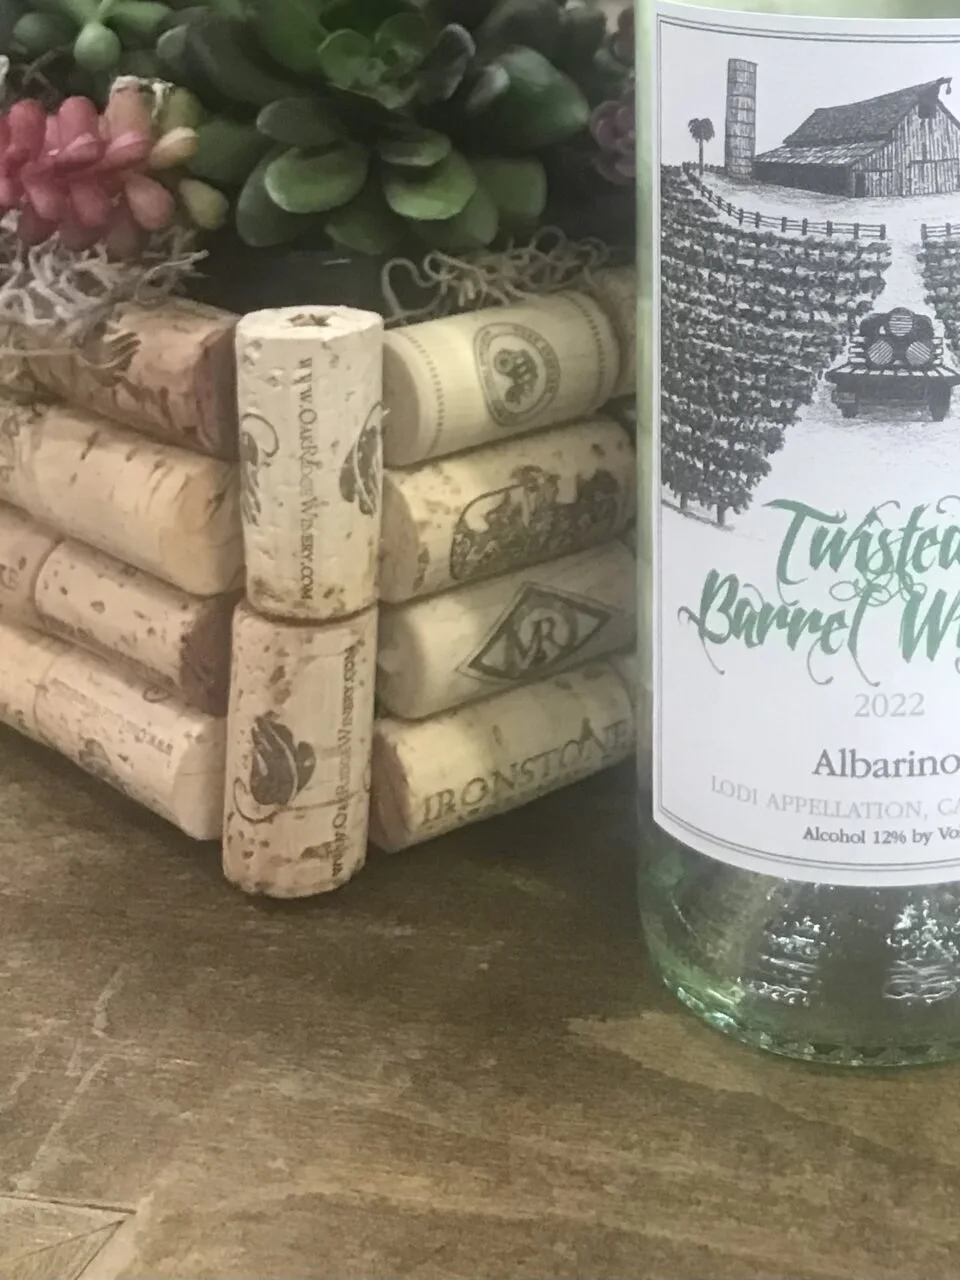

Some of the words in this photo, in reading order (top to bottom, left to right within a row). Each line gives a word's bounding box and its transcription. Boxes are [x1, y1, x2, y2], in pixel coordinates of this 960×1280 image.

[678, 568, 884, 686] Barrel
[853, 692, 925, 718] 2022
[420, 718, 630, 827] IRONSTONE
[710, 774, 758, 806] LODI
[766, 792, 928, 821] APPELLATION,
[802, 826, 866, 844] Alcohol
[872, 830, 907, 845] 12%
[912, 827, 933, 847] by
